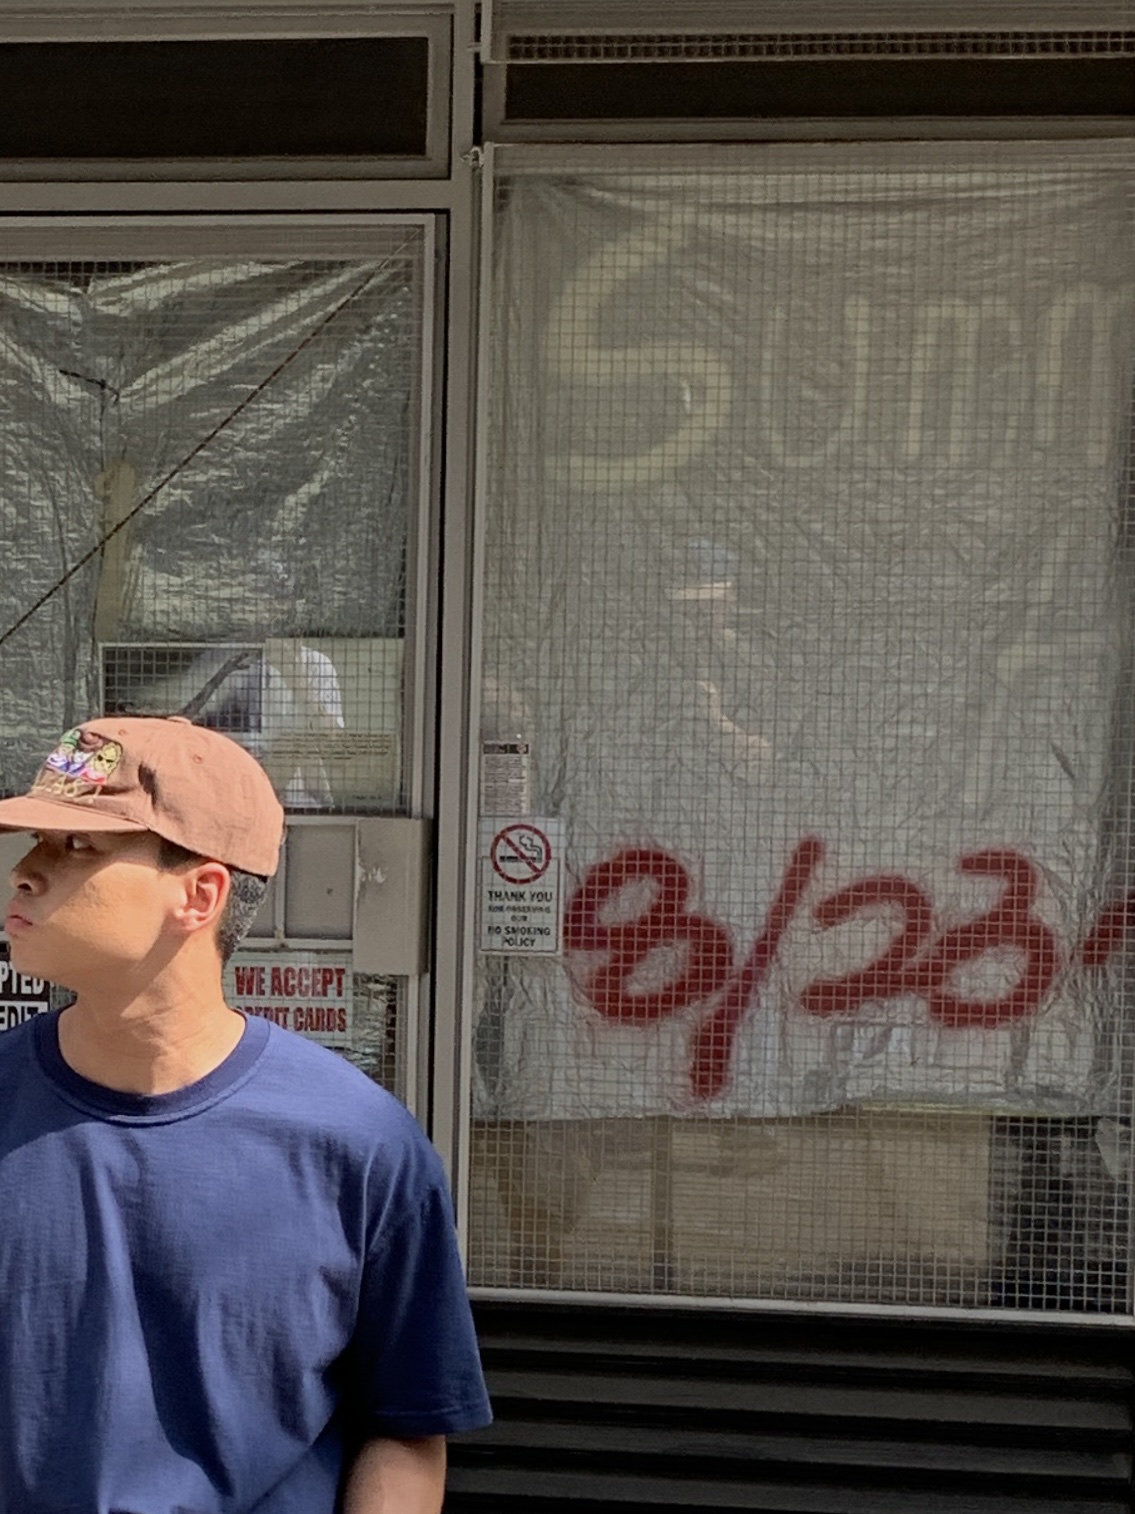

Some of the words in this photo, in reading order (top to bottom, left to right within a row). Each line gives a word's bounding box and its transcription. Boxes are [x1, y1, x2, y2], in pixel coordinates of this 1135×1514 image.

[487, 890, 527, 902] THANK
[530, 891, 553, 903] YOU
[487, 925, 502, 936] NO
[504, 925, 551, 936] SMOKING
[502, 936, 536, 947] POLICY
[234, 966, 266, 996] WE
[270, 966, 346, 997] ACCEPT
[293, 1006, 347, 1032] CARDS
